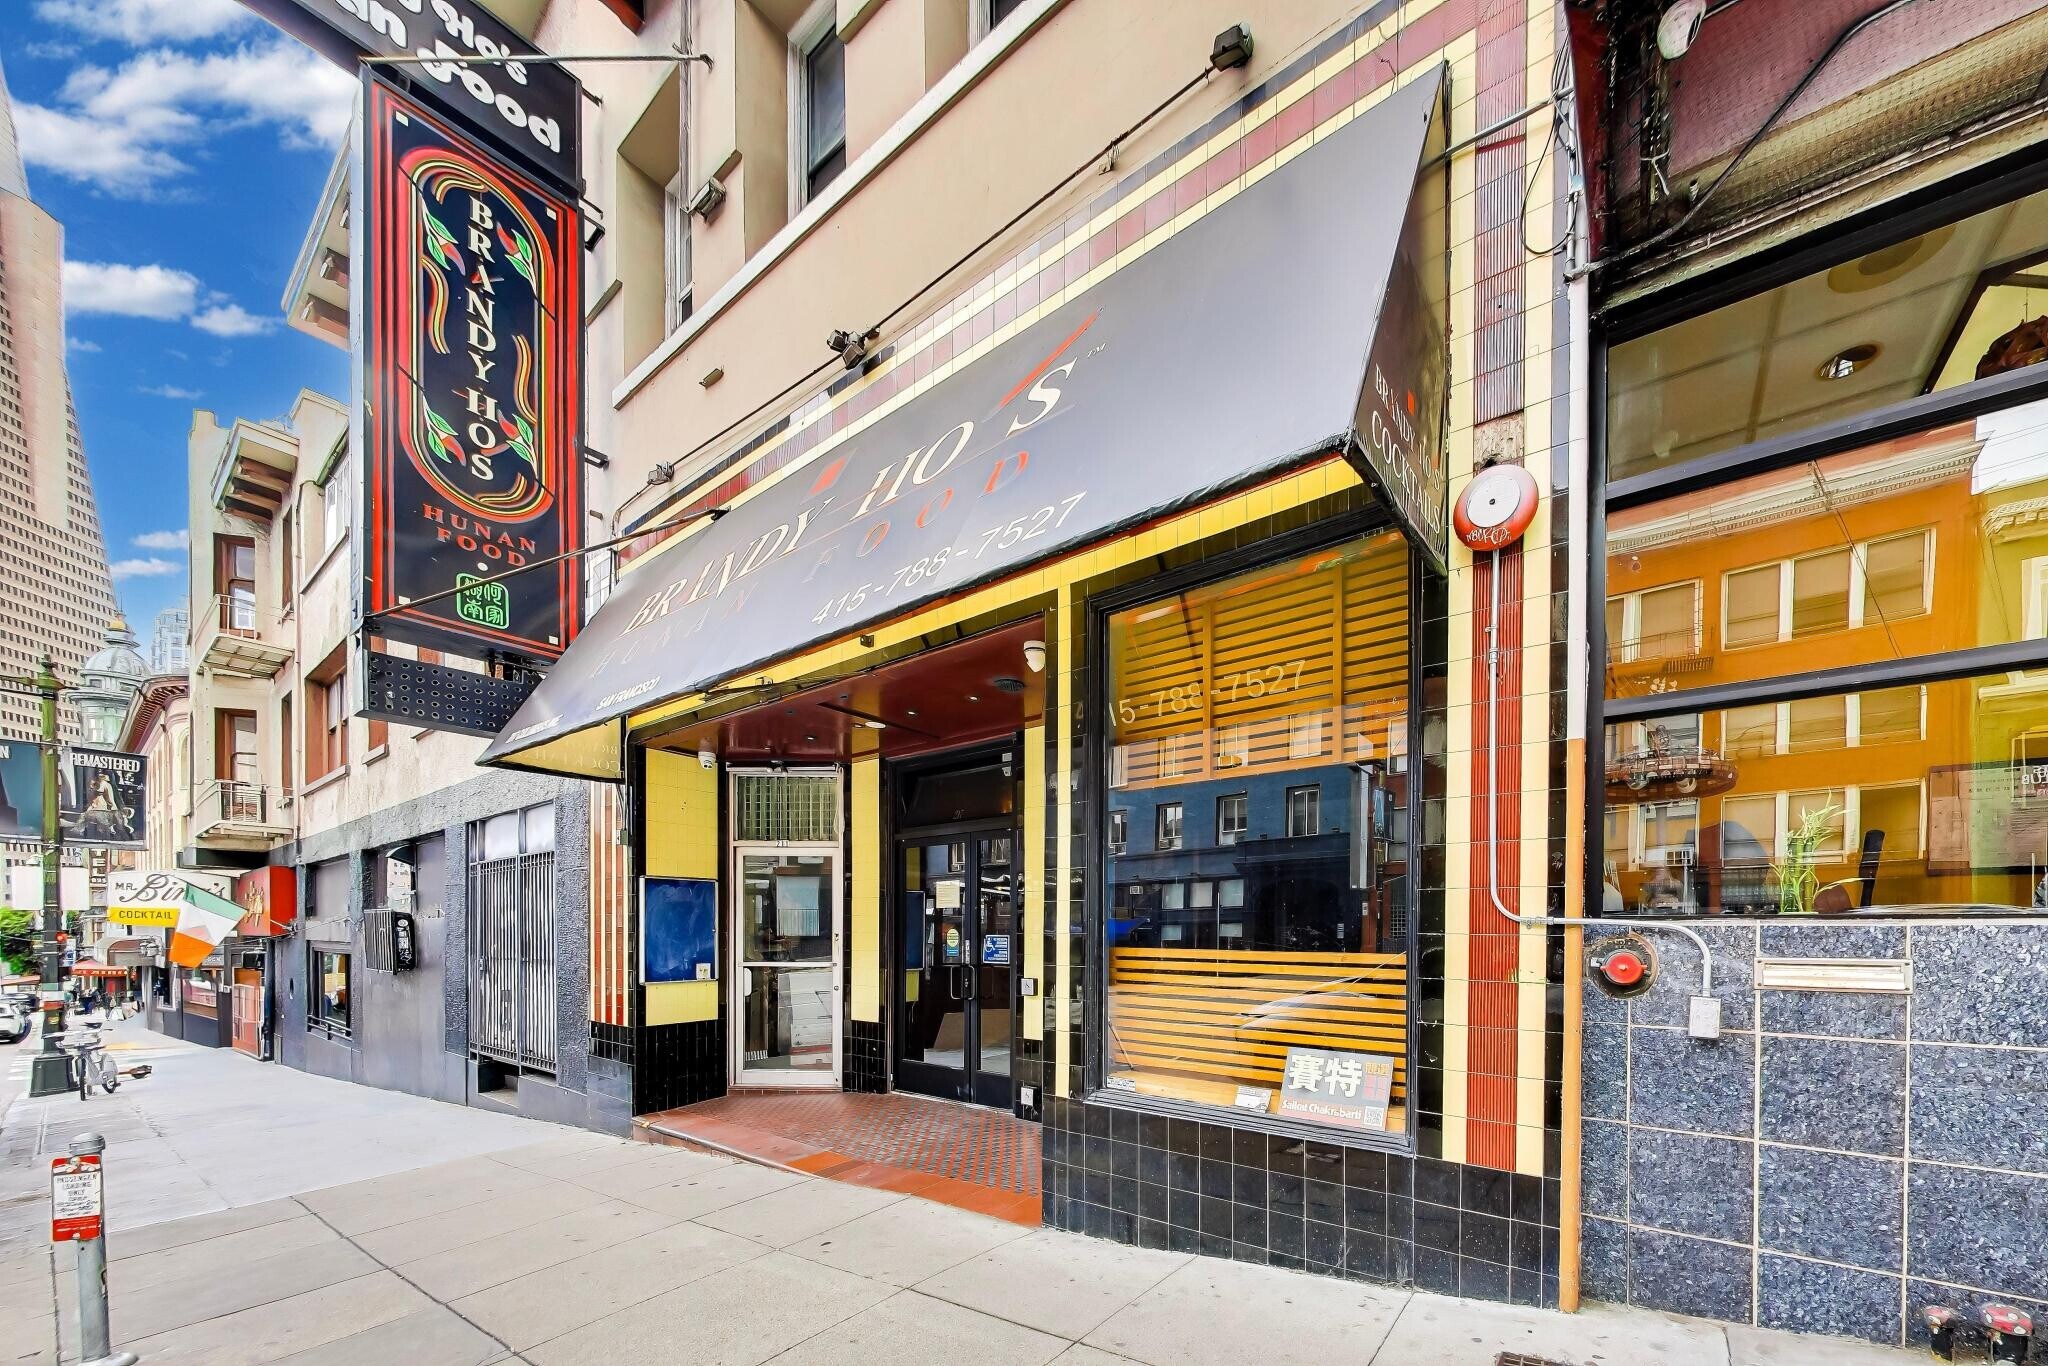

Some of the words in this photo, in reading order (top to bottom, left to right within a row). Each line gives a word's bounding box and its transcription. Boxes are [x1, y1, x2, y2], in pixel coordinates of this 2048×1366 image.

[416, 39, 561, 153] Food
[466, 195, 498, 382] BRANDY
[1371, 410, 1441, 534] COCKTAILS
[423, 503, 536, 555] HUNAN
[437, 526, 526, 567] FOOD
[811, 489, 1088, 626] 415-788-7527
[70, 752, 141, 773] REMASTERED
[1288, 1054, 1363, 1098] 賽特
